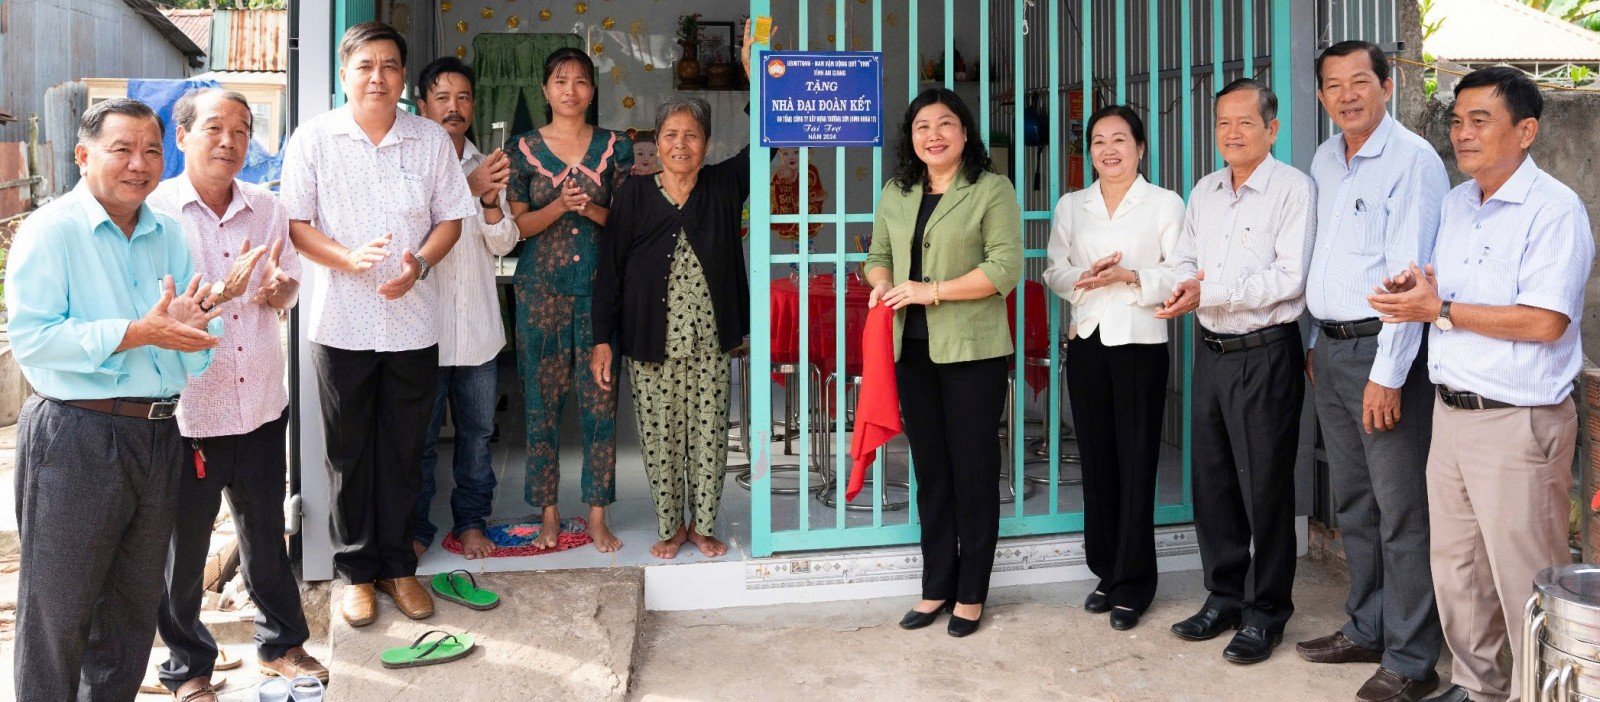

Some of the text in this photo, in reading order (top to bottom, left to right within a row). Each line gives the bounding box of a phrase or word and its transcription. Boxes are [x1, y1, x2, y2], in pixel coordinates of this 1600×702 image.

[806, 79, 838, 94] TẶNG
[772, 94, 872, 114] NHÀ ĐẠI ĐOÀN KẾT
[803, 124, 842, 133] Tài Trợ
